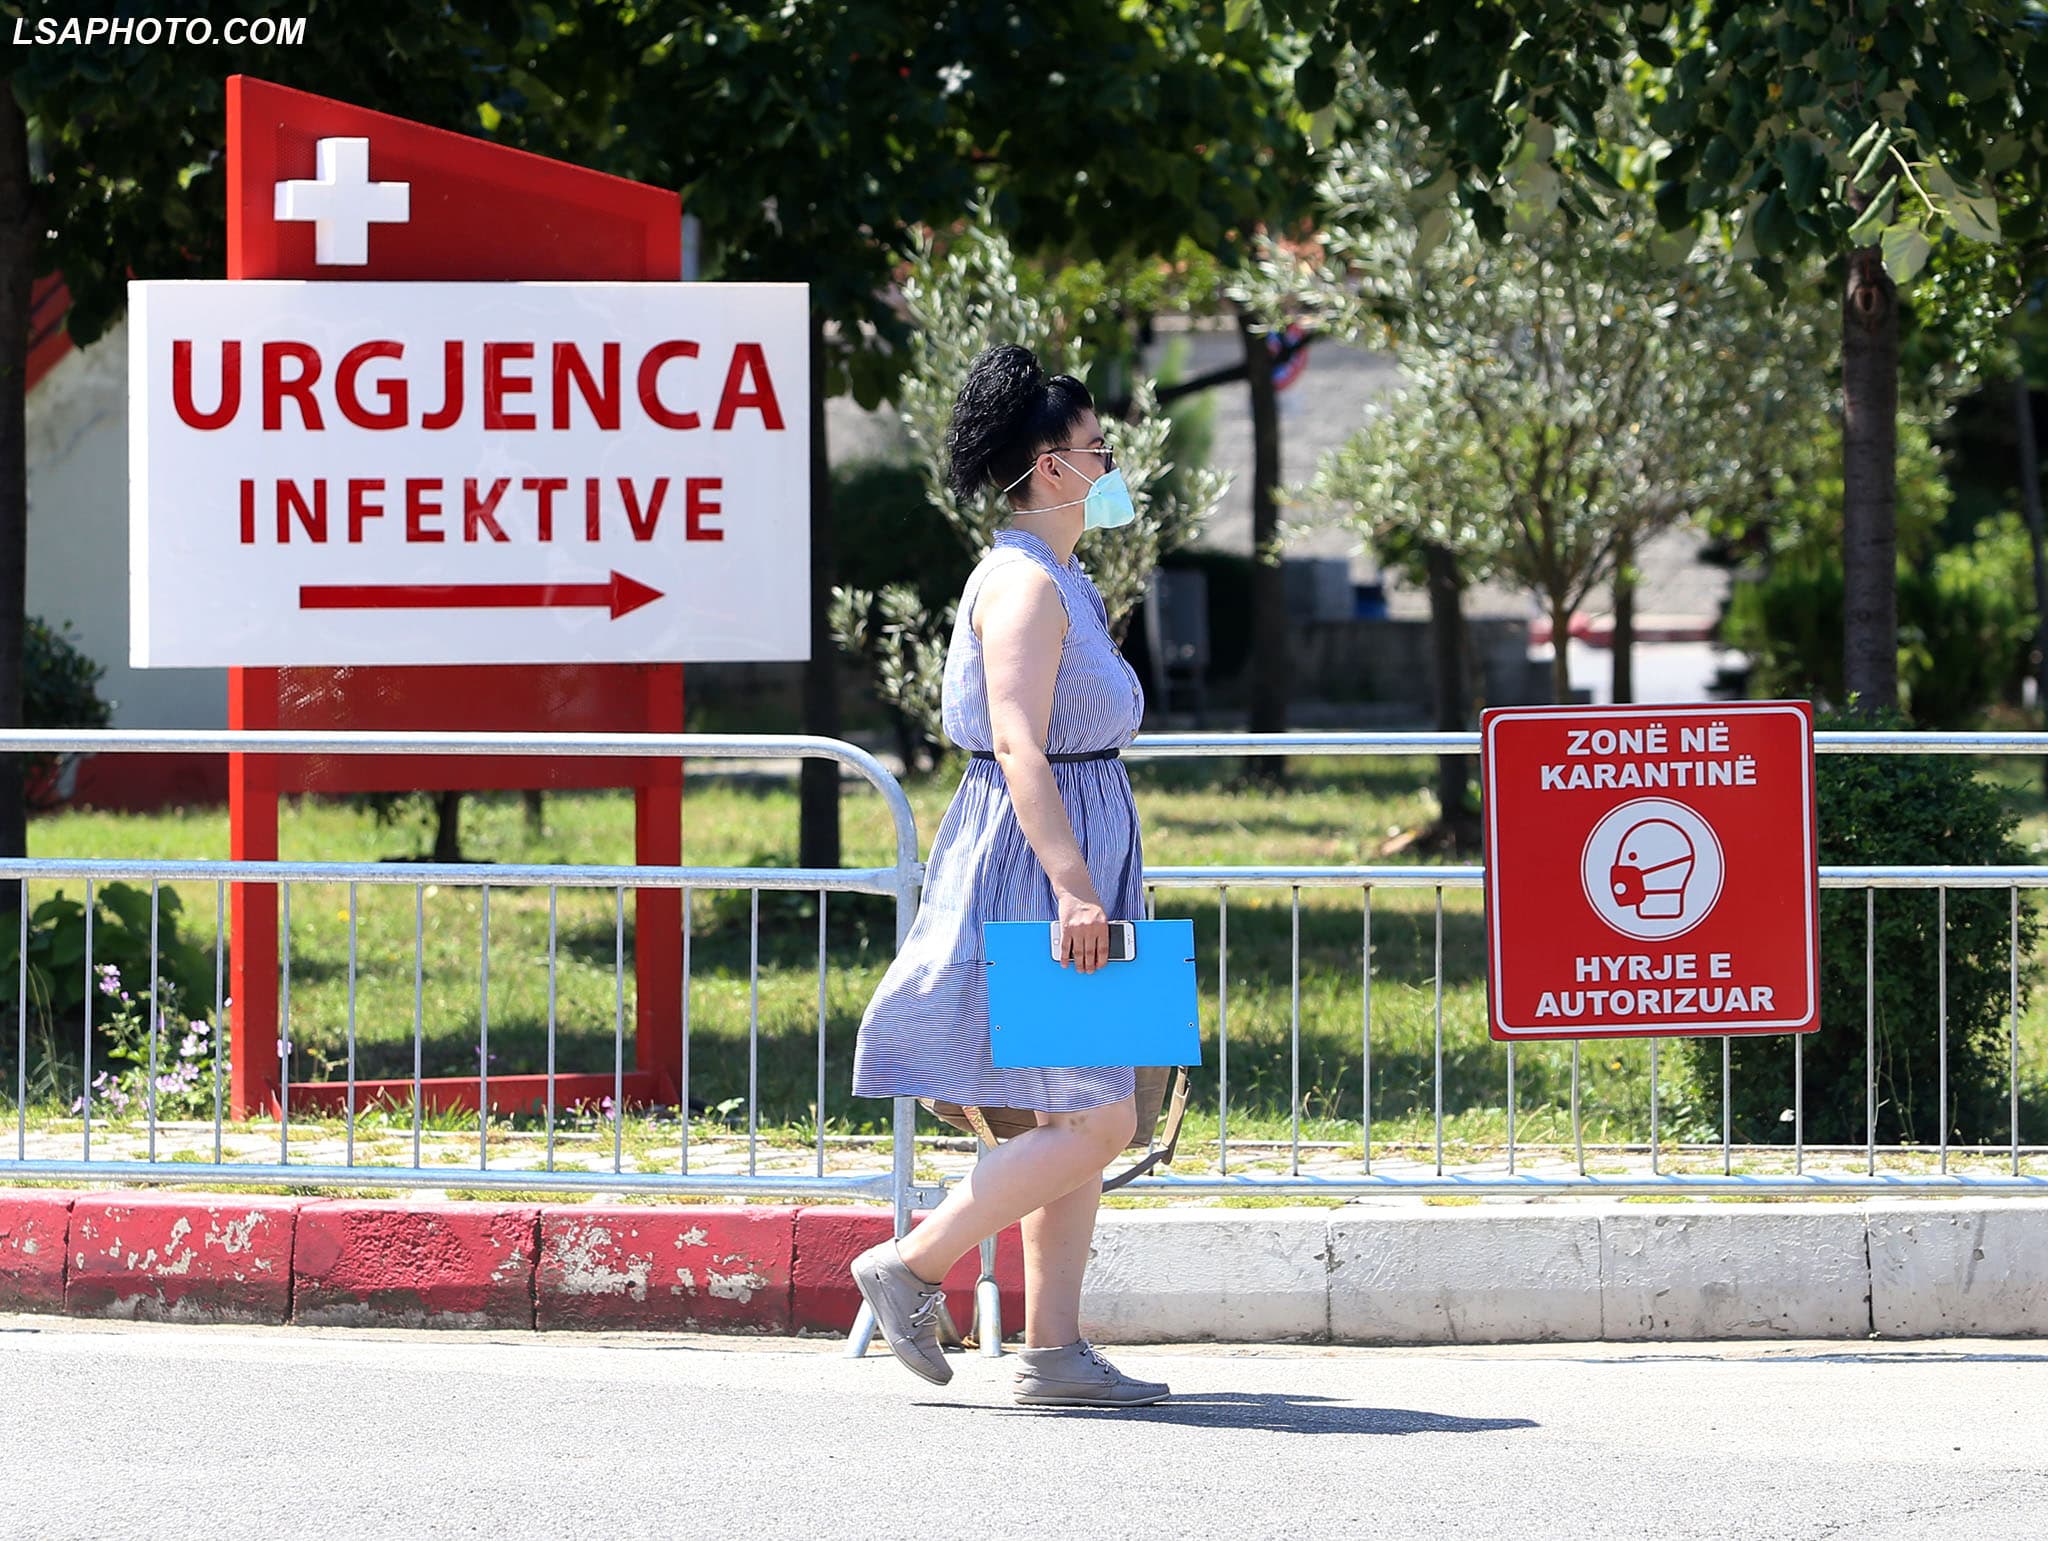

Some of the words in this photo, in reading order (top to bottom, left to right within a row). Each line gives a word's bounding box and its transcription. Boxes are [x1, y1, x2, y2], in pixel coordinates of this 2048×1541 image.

[173, 340, 784, 431] URGJENCA
[241, 478, 723, 544] INFEKTIVE
[1567, 723, 1667, 755] ZONË
[1681, 722, 1729, 752] NË
[1541, 755, 1756, 789] KARANTINË
[1576, 954, 1696, 981] HYRJE
[1710, 954, 1731, 978] E
[1535, 987, 1774, 1017] AUTORIZUAR
